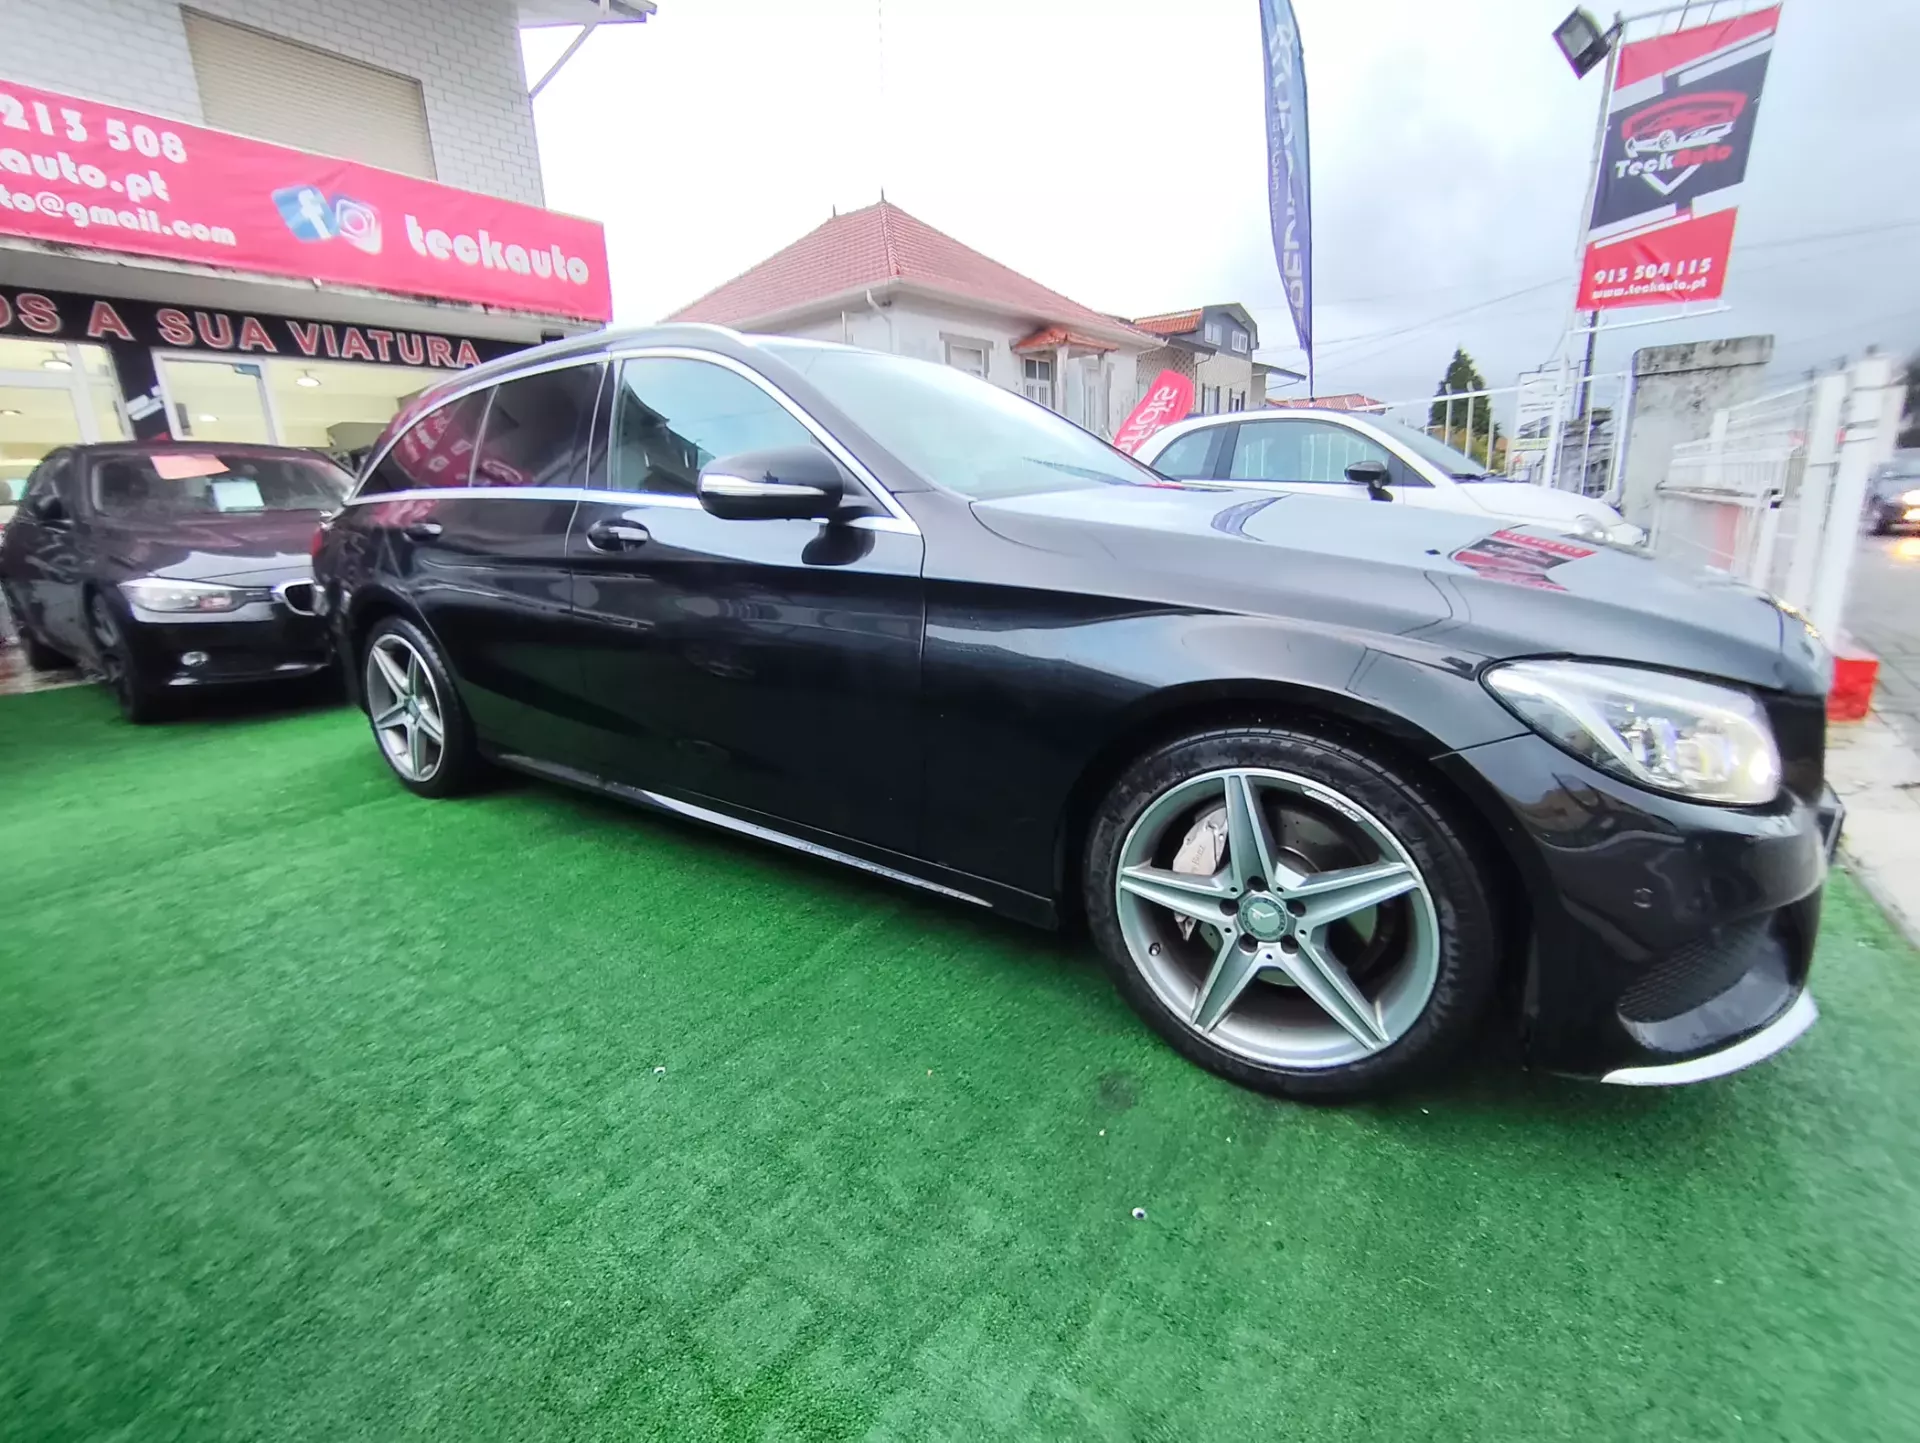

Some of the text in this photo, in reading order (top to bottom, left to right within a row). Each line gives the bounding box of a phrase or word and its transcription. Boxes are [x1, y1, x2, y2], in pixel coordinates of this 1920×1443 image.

[0, 94, 188, 164] 213 508
[0, 147, 171, 203] auto.pt
[404, 213, 589, 285] teckauto
[1633, 262, 1671, 280] 504
[1677, 257, 1712, 276] 115
[1592, 276, 1708, 299] www.teckauto.pt
[0, 292, 483, 370] S A SUA VIATURA
